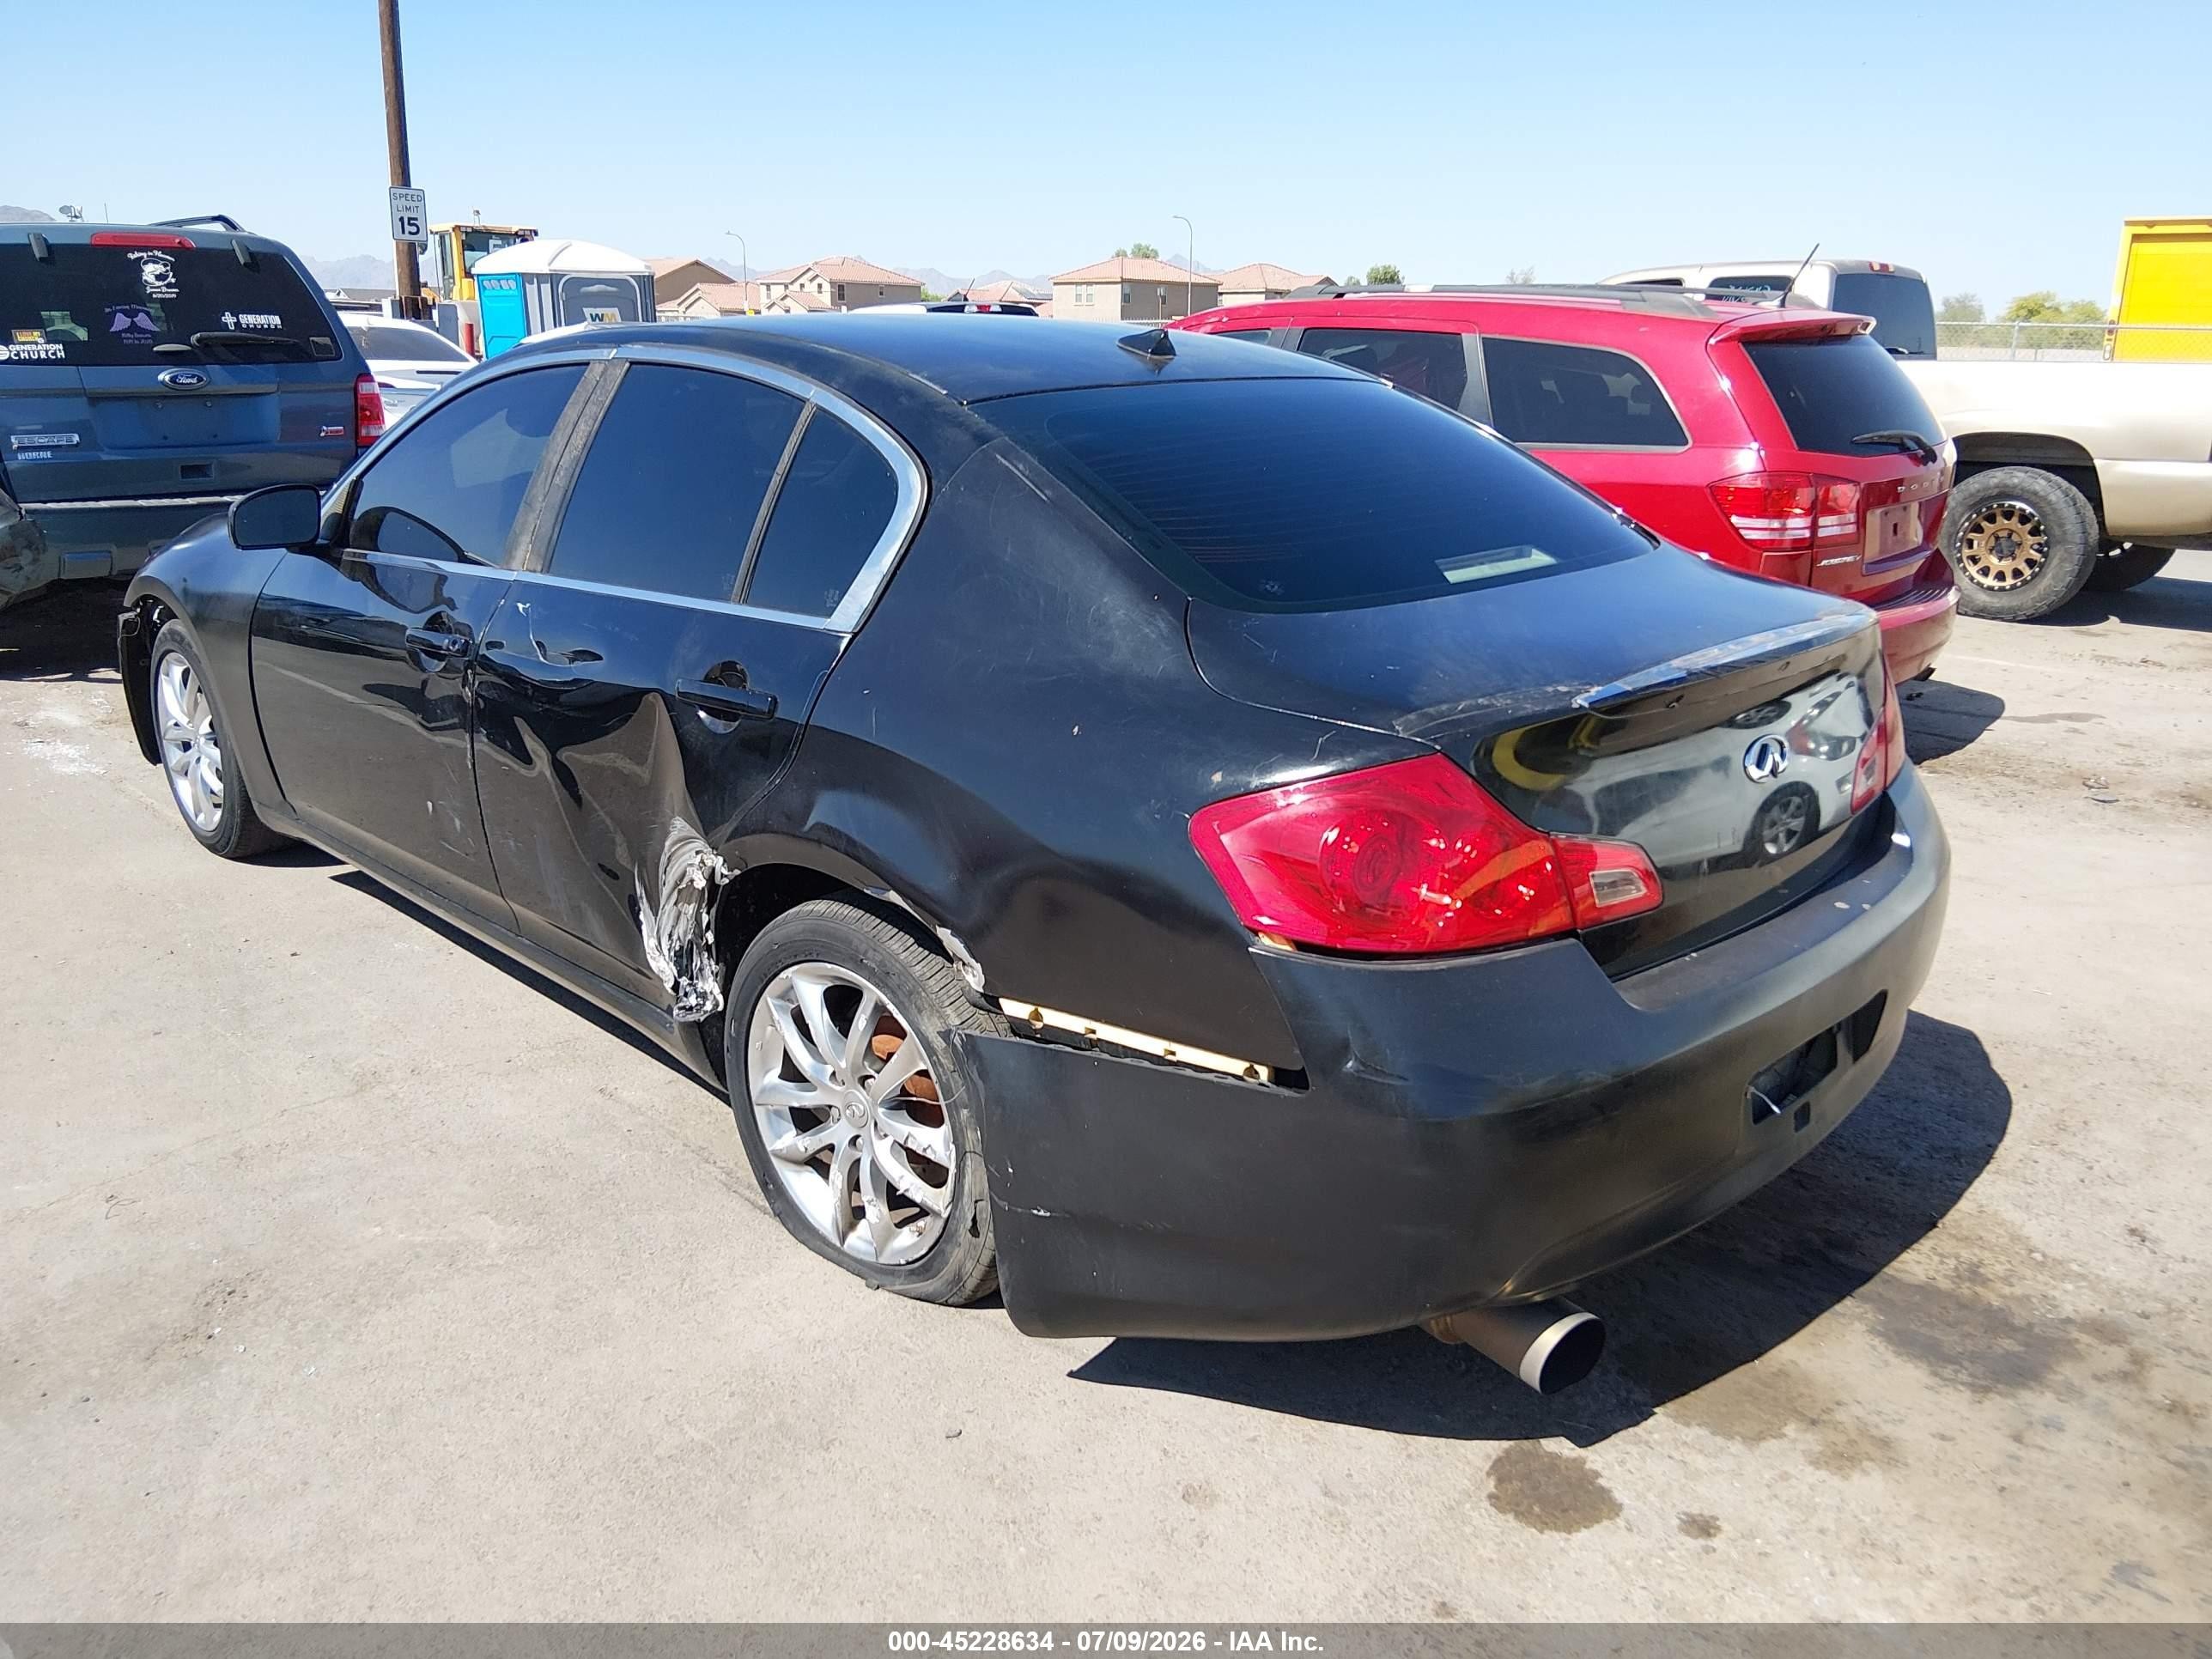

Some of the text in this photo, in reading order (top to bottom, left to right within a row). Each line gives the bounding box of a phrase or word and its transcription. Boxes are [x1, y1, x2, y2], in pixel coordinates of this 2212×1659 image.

[392, 192, 422, 203] SPEED
[396, 204, 420, 214] LIMIT
[398, 216, 421, 236] 15
[239, 313, 282, 325] GENERATION
[10, 349, 65, 360] CHURCH
[176, 374, 198, 384] Ford
[15, 435, 76, 446] ESCAPE
[17, 450, 53, 460] HORNE
